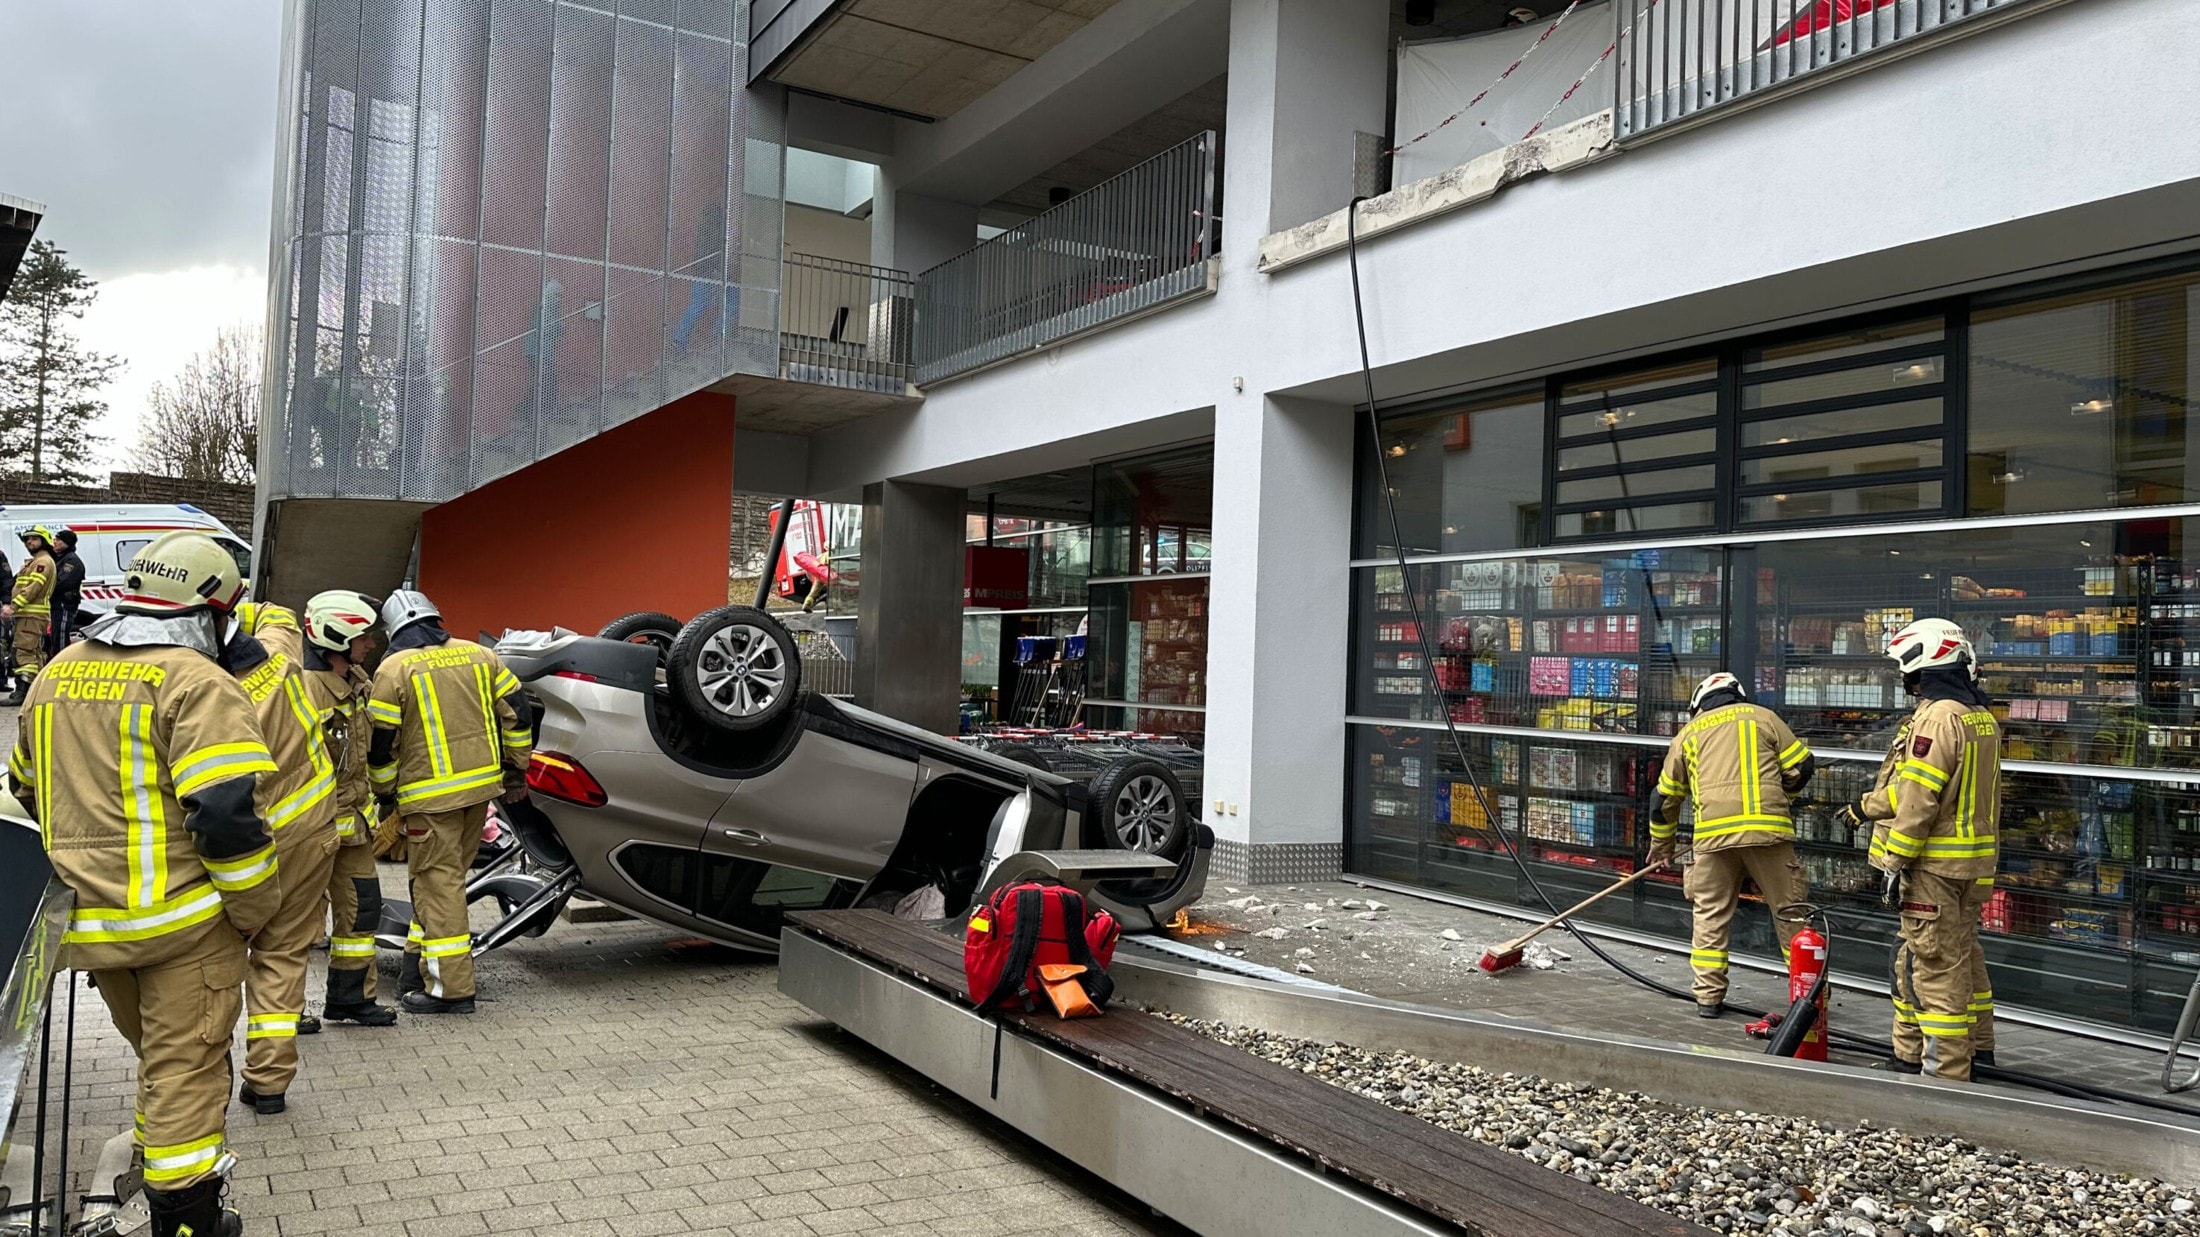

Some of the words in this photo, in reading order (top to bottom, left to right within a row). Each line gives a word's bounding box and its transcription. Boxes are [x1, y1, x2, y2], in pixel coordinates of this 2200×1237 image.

[42, 661, 167, 688] FEUERWEHR
[240, 653, 289, 693] RWEHR
[54, 678, 128, 700] FÜGEN
[251, 675, 284, 705] GEN
